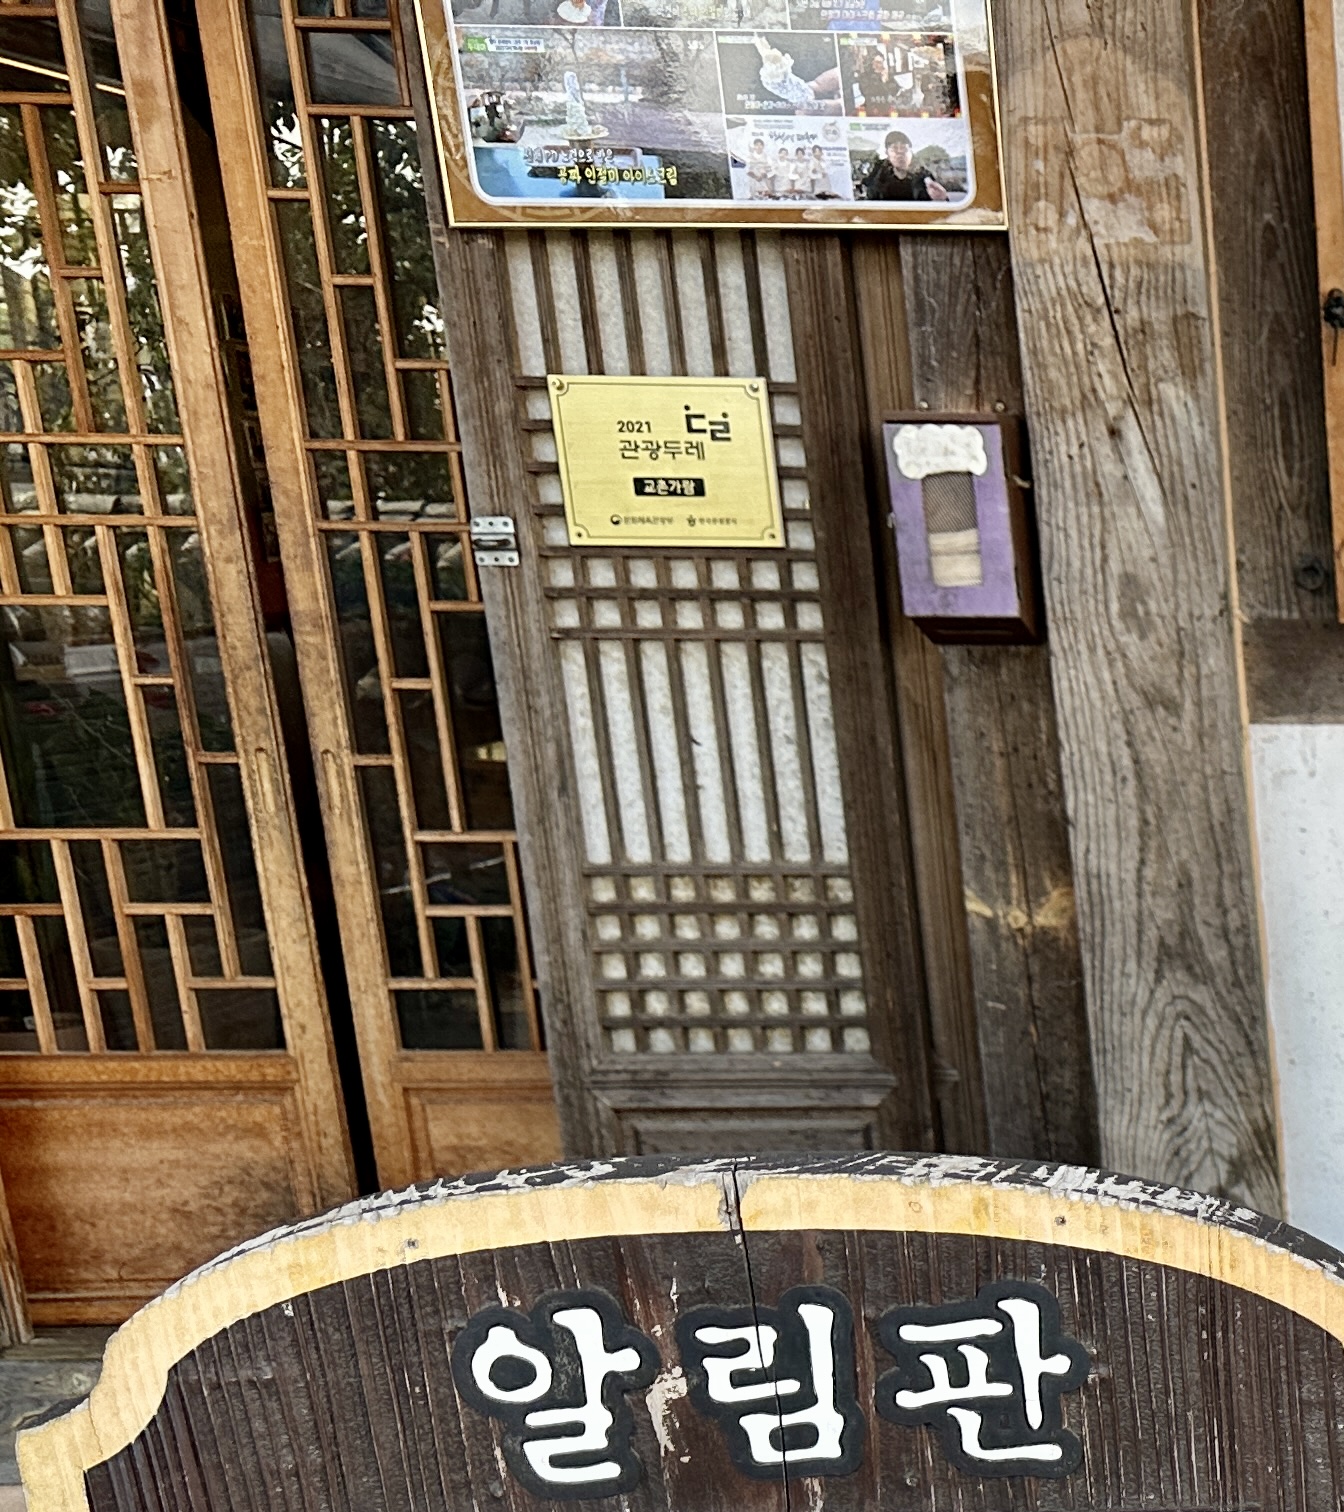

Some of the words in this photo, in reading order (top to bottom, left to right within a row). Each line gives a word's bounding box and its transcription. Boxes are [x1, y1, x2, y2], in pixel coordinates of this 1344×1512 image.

[584, 164, 620, 185] 인절미
[616, 420, 653, 434] 2021
[618, 439, 706, 461] 관광두레
[643, 479, 697, 496] 교촌가람
[468, 1296, 1072, 1486] 알림판
